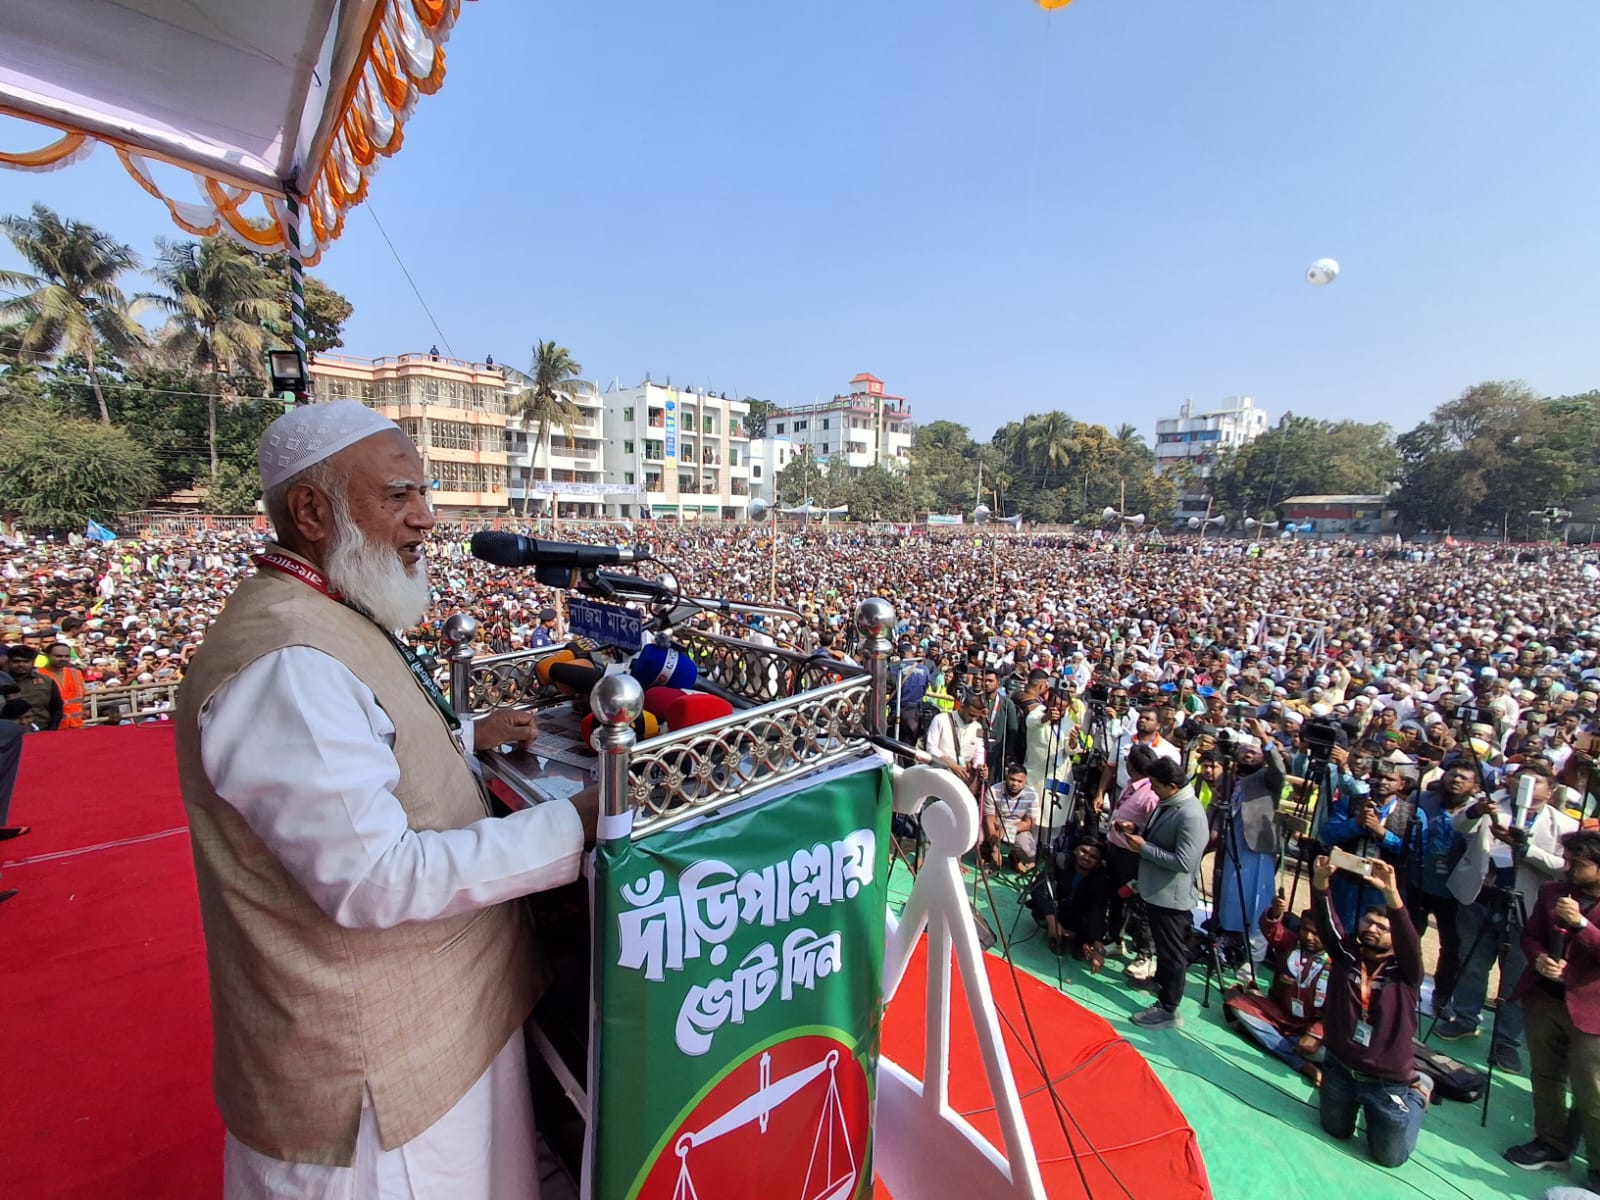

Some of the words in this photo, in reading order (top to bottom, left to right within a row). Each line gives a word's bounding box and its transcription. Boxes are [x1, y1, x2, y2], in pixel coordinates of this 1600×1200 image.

[261, 553, 323, 586] বাংলাদে
[569, 601, 602, 629] নাজিম
[607, 611, 640, 637] মাইক
[616, 828, 875, 981] দাঁড়িপাল্লায়
[674, 941, 779, 1056] ভোট
[781, 928, 842, 1001] দিন
